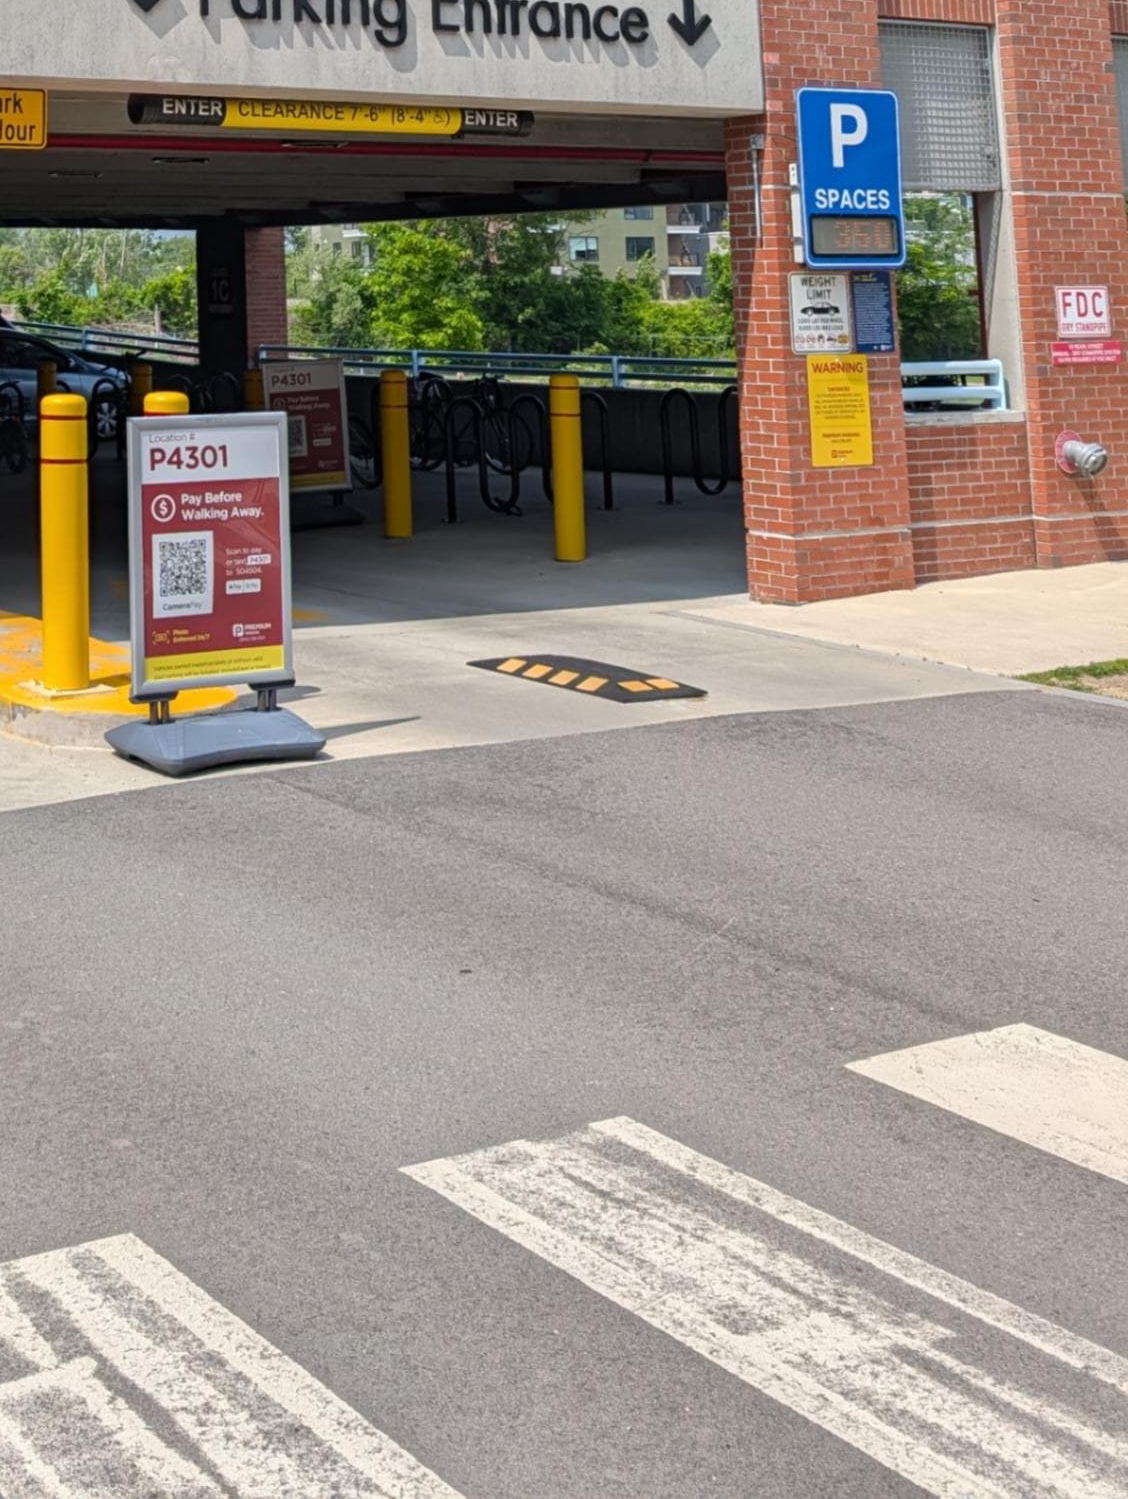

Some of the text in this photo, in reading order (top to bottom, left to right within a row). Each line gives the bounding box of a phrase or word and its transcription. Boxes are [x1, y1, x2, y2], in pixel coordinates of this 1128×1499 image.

[161, 98, 223, 117] ENTER
[238, 101, 345, 122] CLEARANCE
[464, 110, 518, 127] ENTER
[829, 102, 869, 169] P
[814, 187, 891, 210] SPACES
[800, 276, 837, 287] WEIGHT
[806, 288, 832, 300] LIMIT
[1061, 291, 1104, 318] FDC
[1075, 322, 1107, 332] STANDPIPE
[811, 362, 864, 373] WARNING
[272, 373, 312, 387] P4301
[148, 433, 187, 444] Location
[149, 444, 228, 471] P4301
[181, 491, 242, 506] Pay Before
[181, 506, 265, 523] Walking Away.
[162, 602, 203, 611] CameraPay
